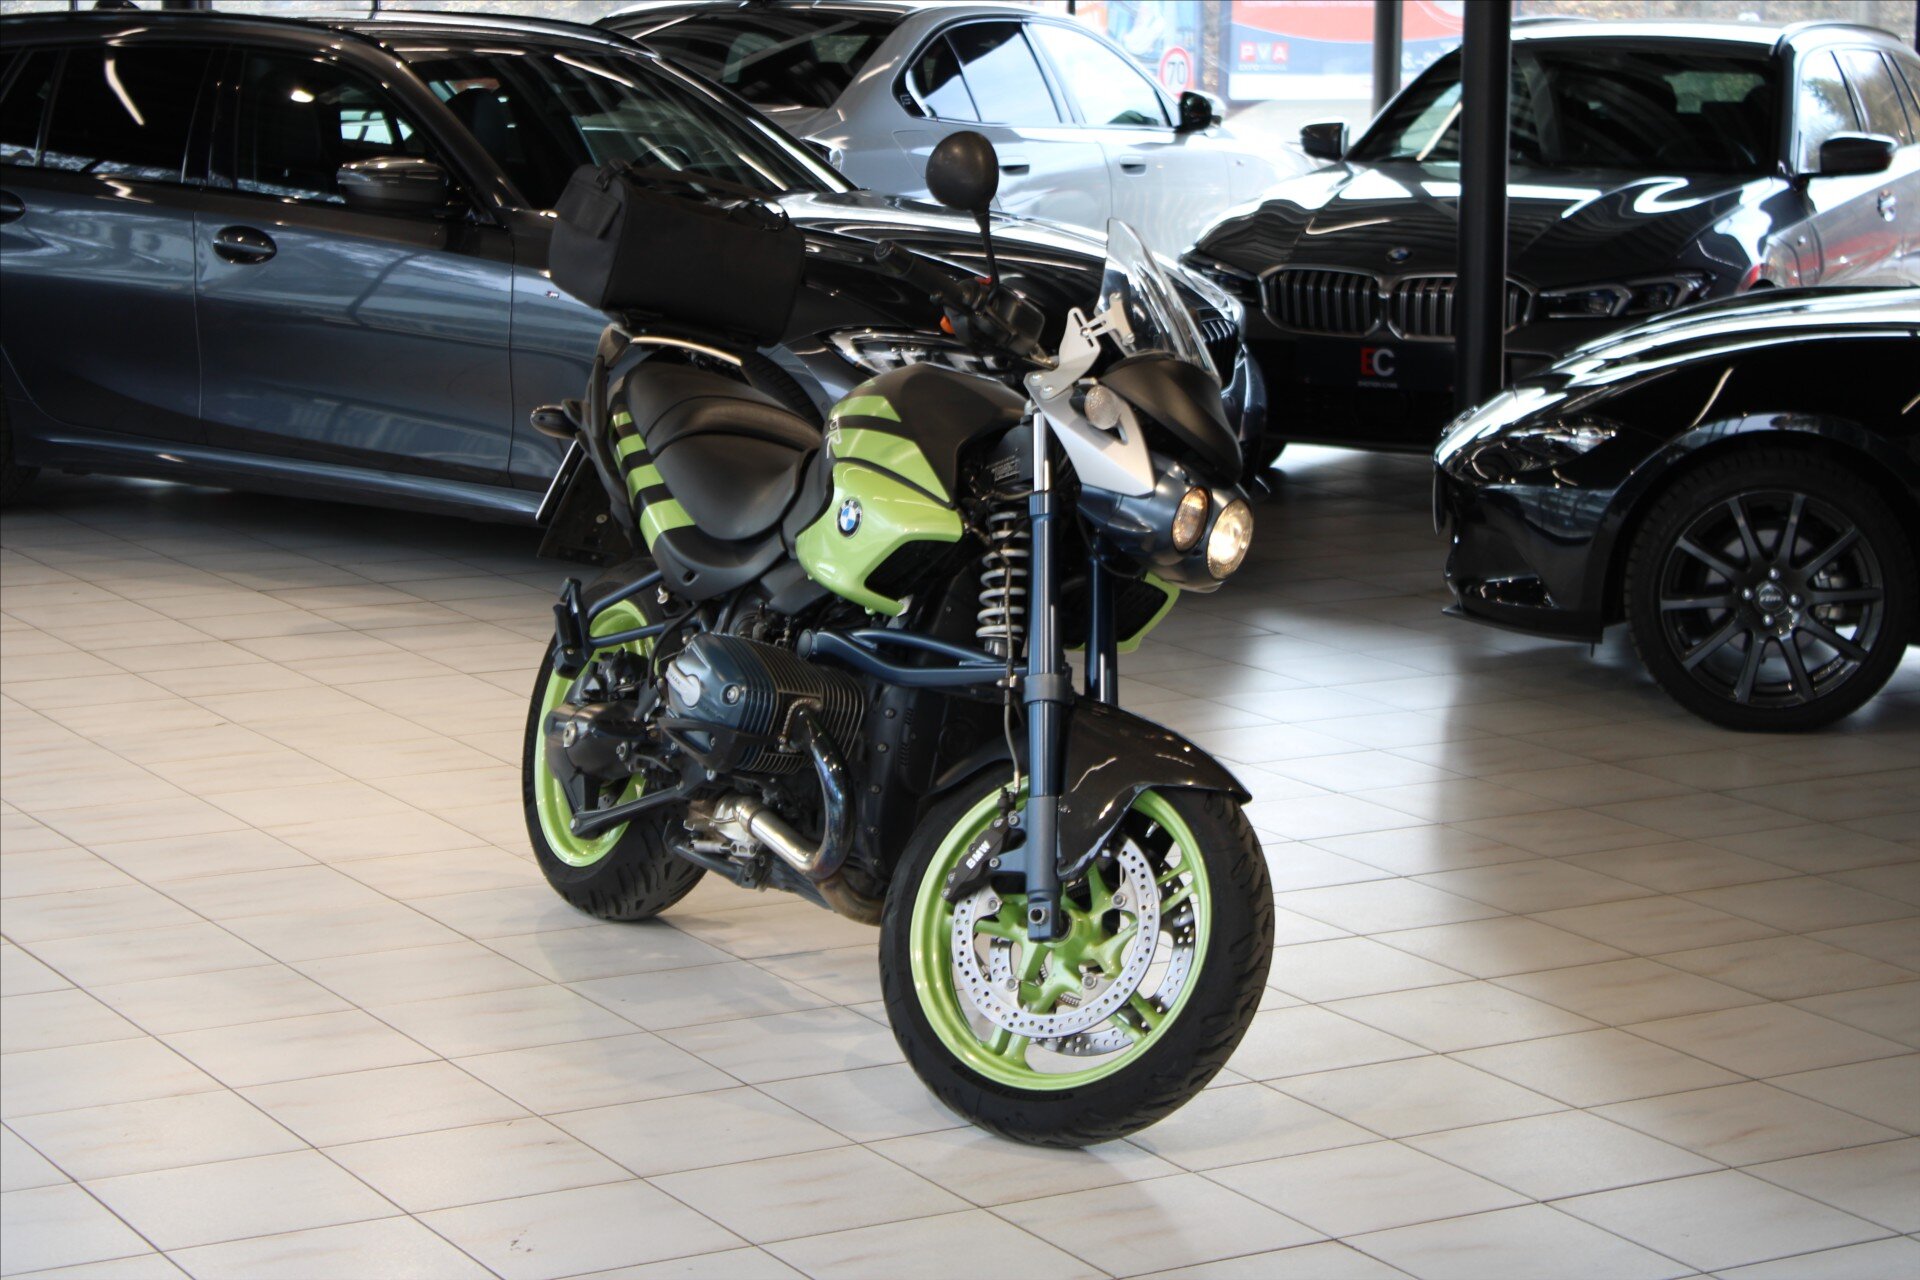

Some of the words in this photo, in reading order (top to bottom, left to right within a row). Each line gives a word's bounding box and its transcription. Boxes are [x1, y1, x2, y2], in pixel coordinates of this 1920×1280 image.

[1240, 44, 1288, 62] PVA
[1167, 60, 1186, 86] 70
[1361, 348, 1395, 376] EC
[966, 841, 990, 869] BMW
